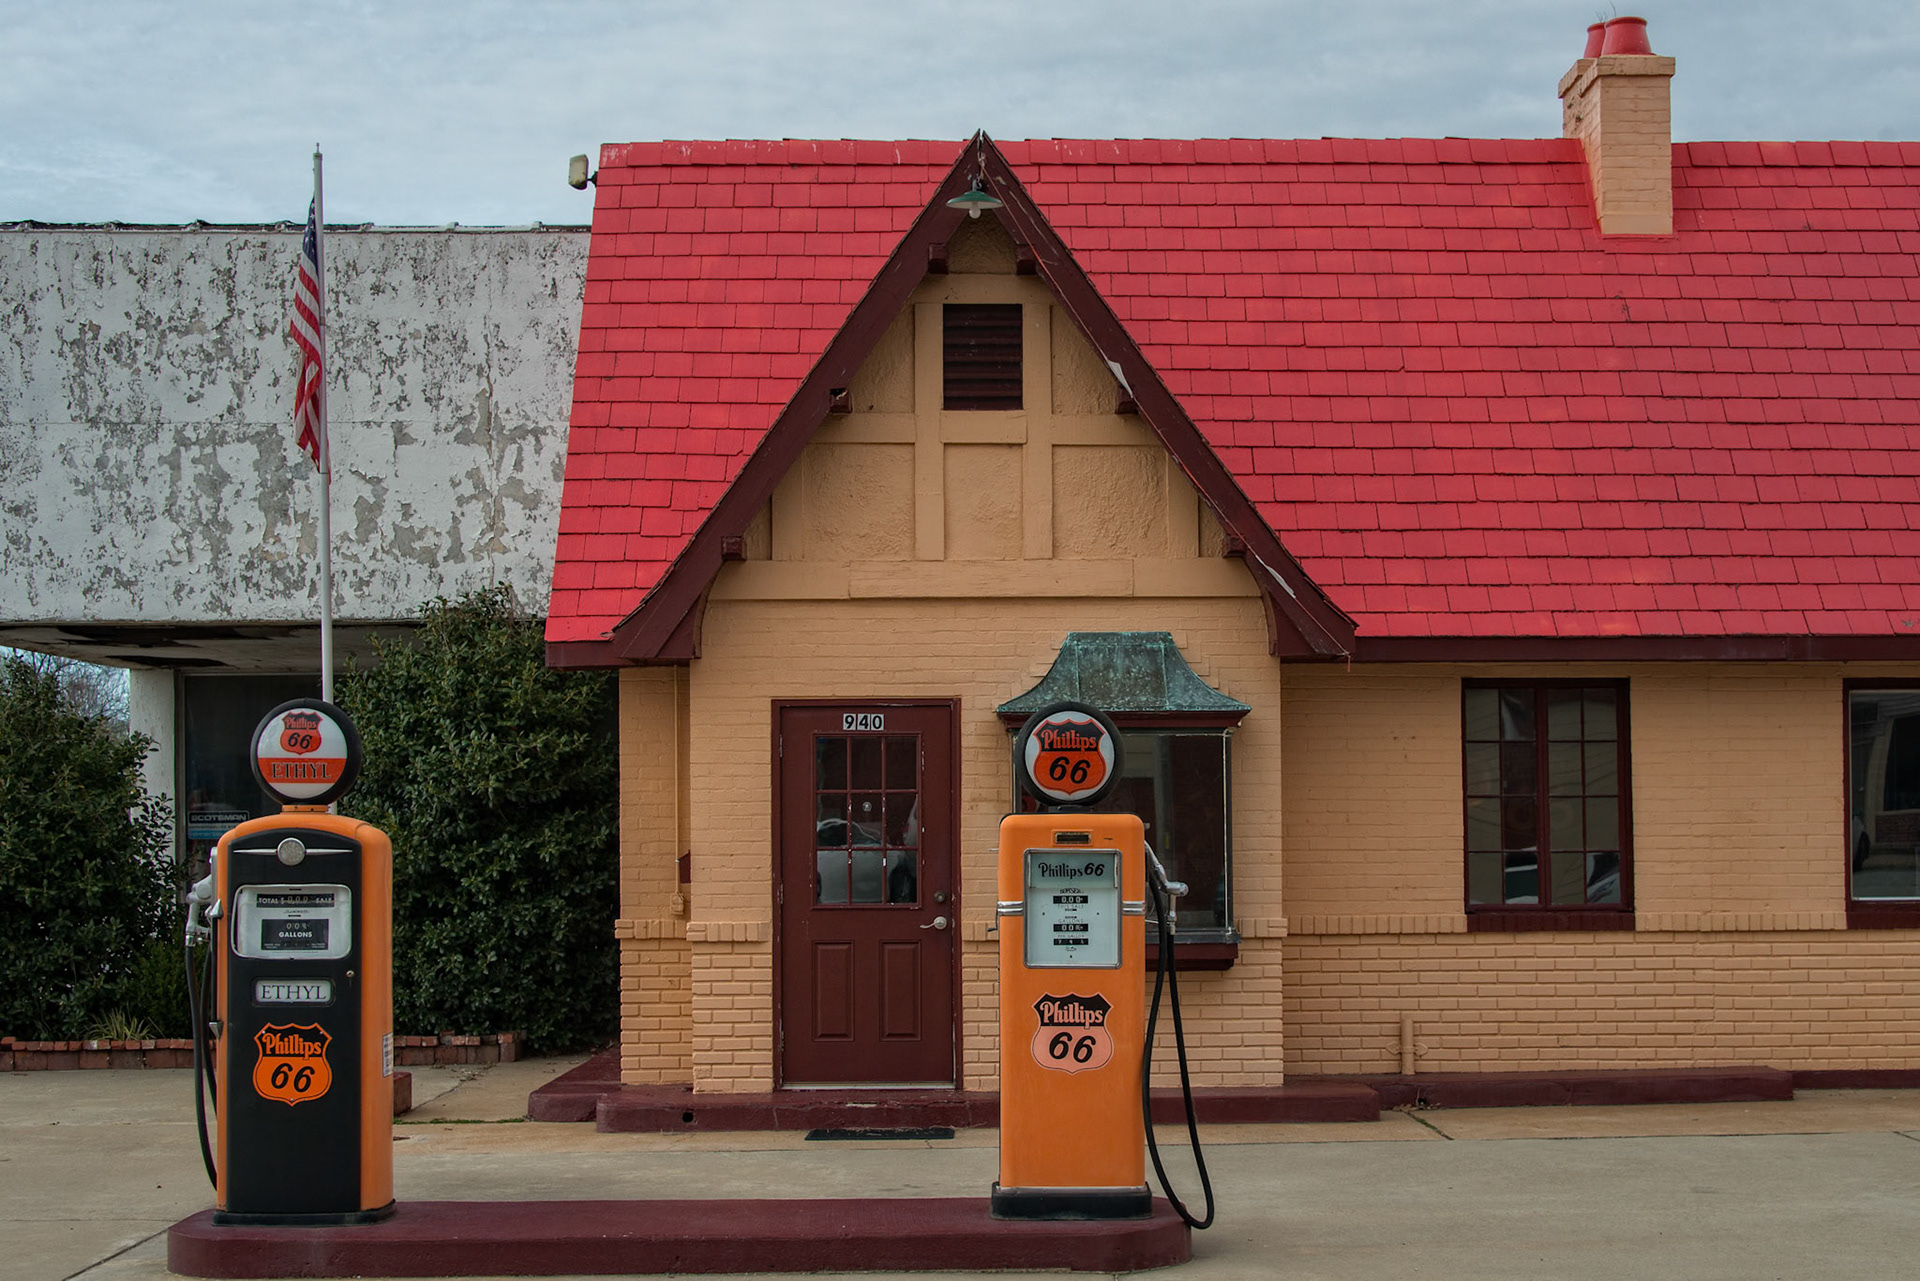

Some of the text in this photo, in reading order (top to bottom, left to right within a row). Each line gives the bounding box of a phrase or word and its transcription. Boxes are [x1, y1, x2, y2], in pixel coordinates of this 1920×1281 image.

[285, 717, 317, 731] Phillips
[844, 714, 883, 730] 940
[287, 732, 313, 749] 66
[1040, 728, 1097, 754] Phillips
[271, 762, 332, 779] ETHYL
[1049, 756, 1091, 784] 66
[1038, 862, 1105, 880] Phillips 66
[261, 985, 326, 1000] ETHYL
[1040, 1001, 1104, 1030] Phillips
[262, 1033, 322, 1060] Phillips
[1049, 1031, 1096, 1063] 66
[271, 1063, 315, 1093] 66
